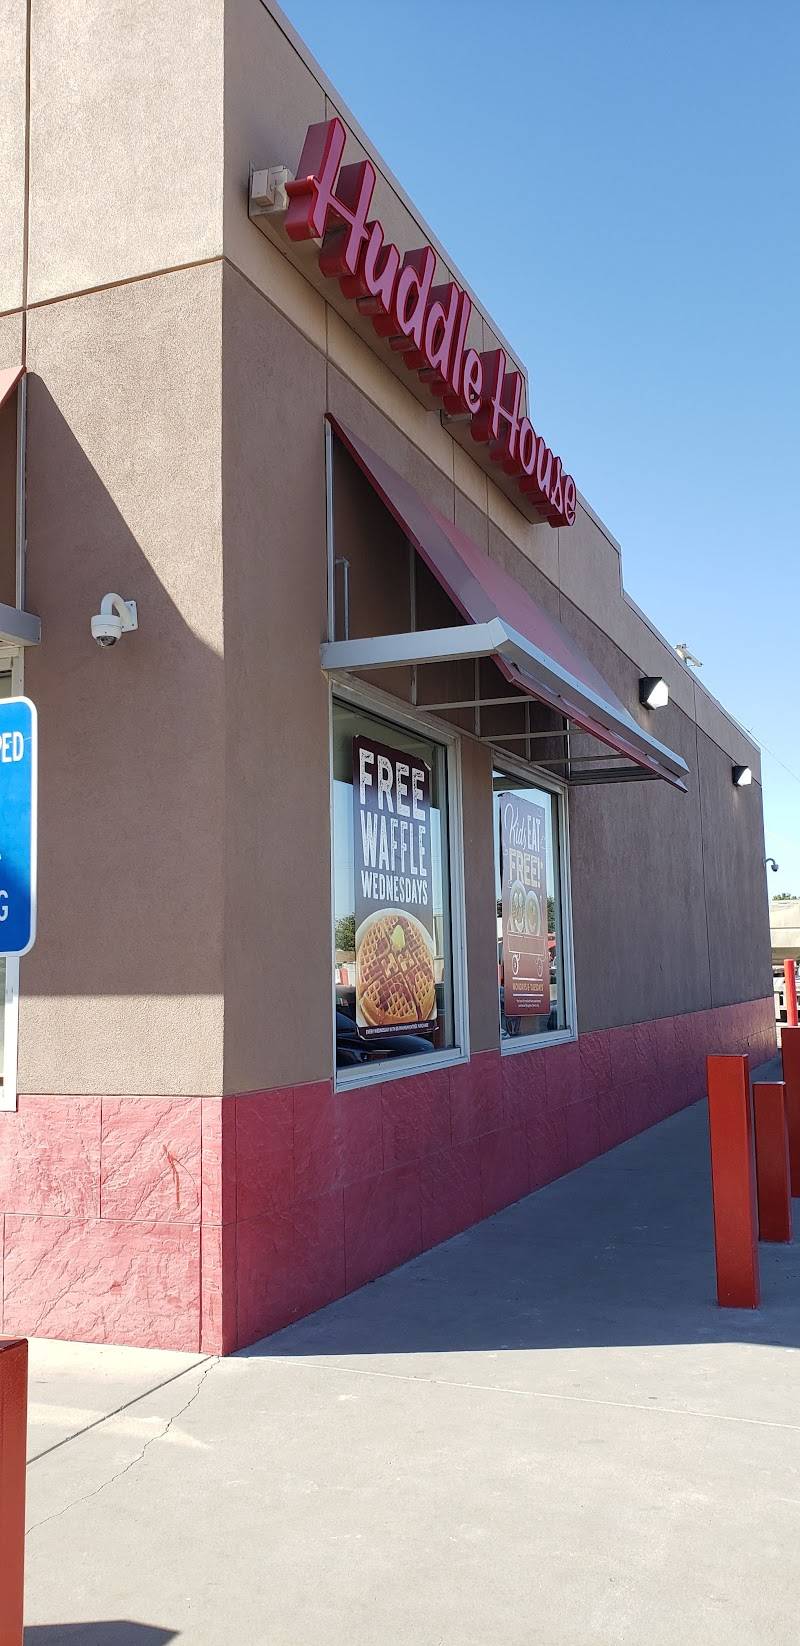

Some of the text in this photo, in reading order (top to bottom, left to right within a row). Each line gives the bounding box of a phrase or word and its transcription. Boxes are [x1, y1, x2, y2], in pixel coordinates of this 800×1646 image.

[286, 117, 577, 528] Huddle House
[0, 731, 24, 763] ED
[359, 747, 426, 822] FREE
[360, 809, 428, 877] WAFFLE
[505, 803, 541, 853] Kids EAT
[361, 870, 428, 906] WEDNESDAYS
